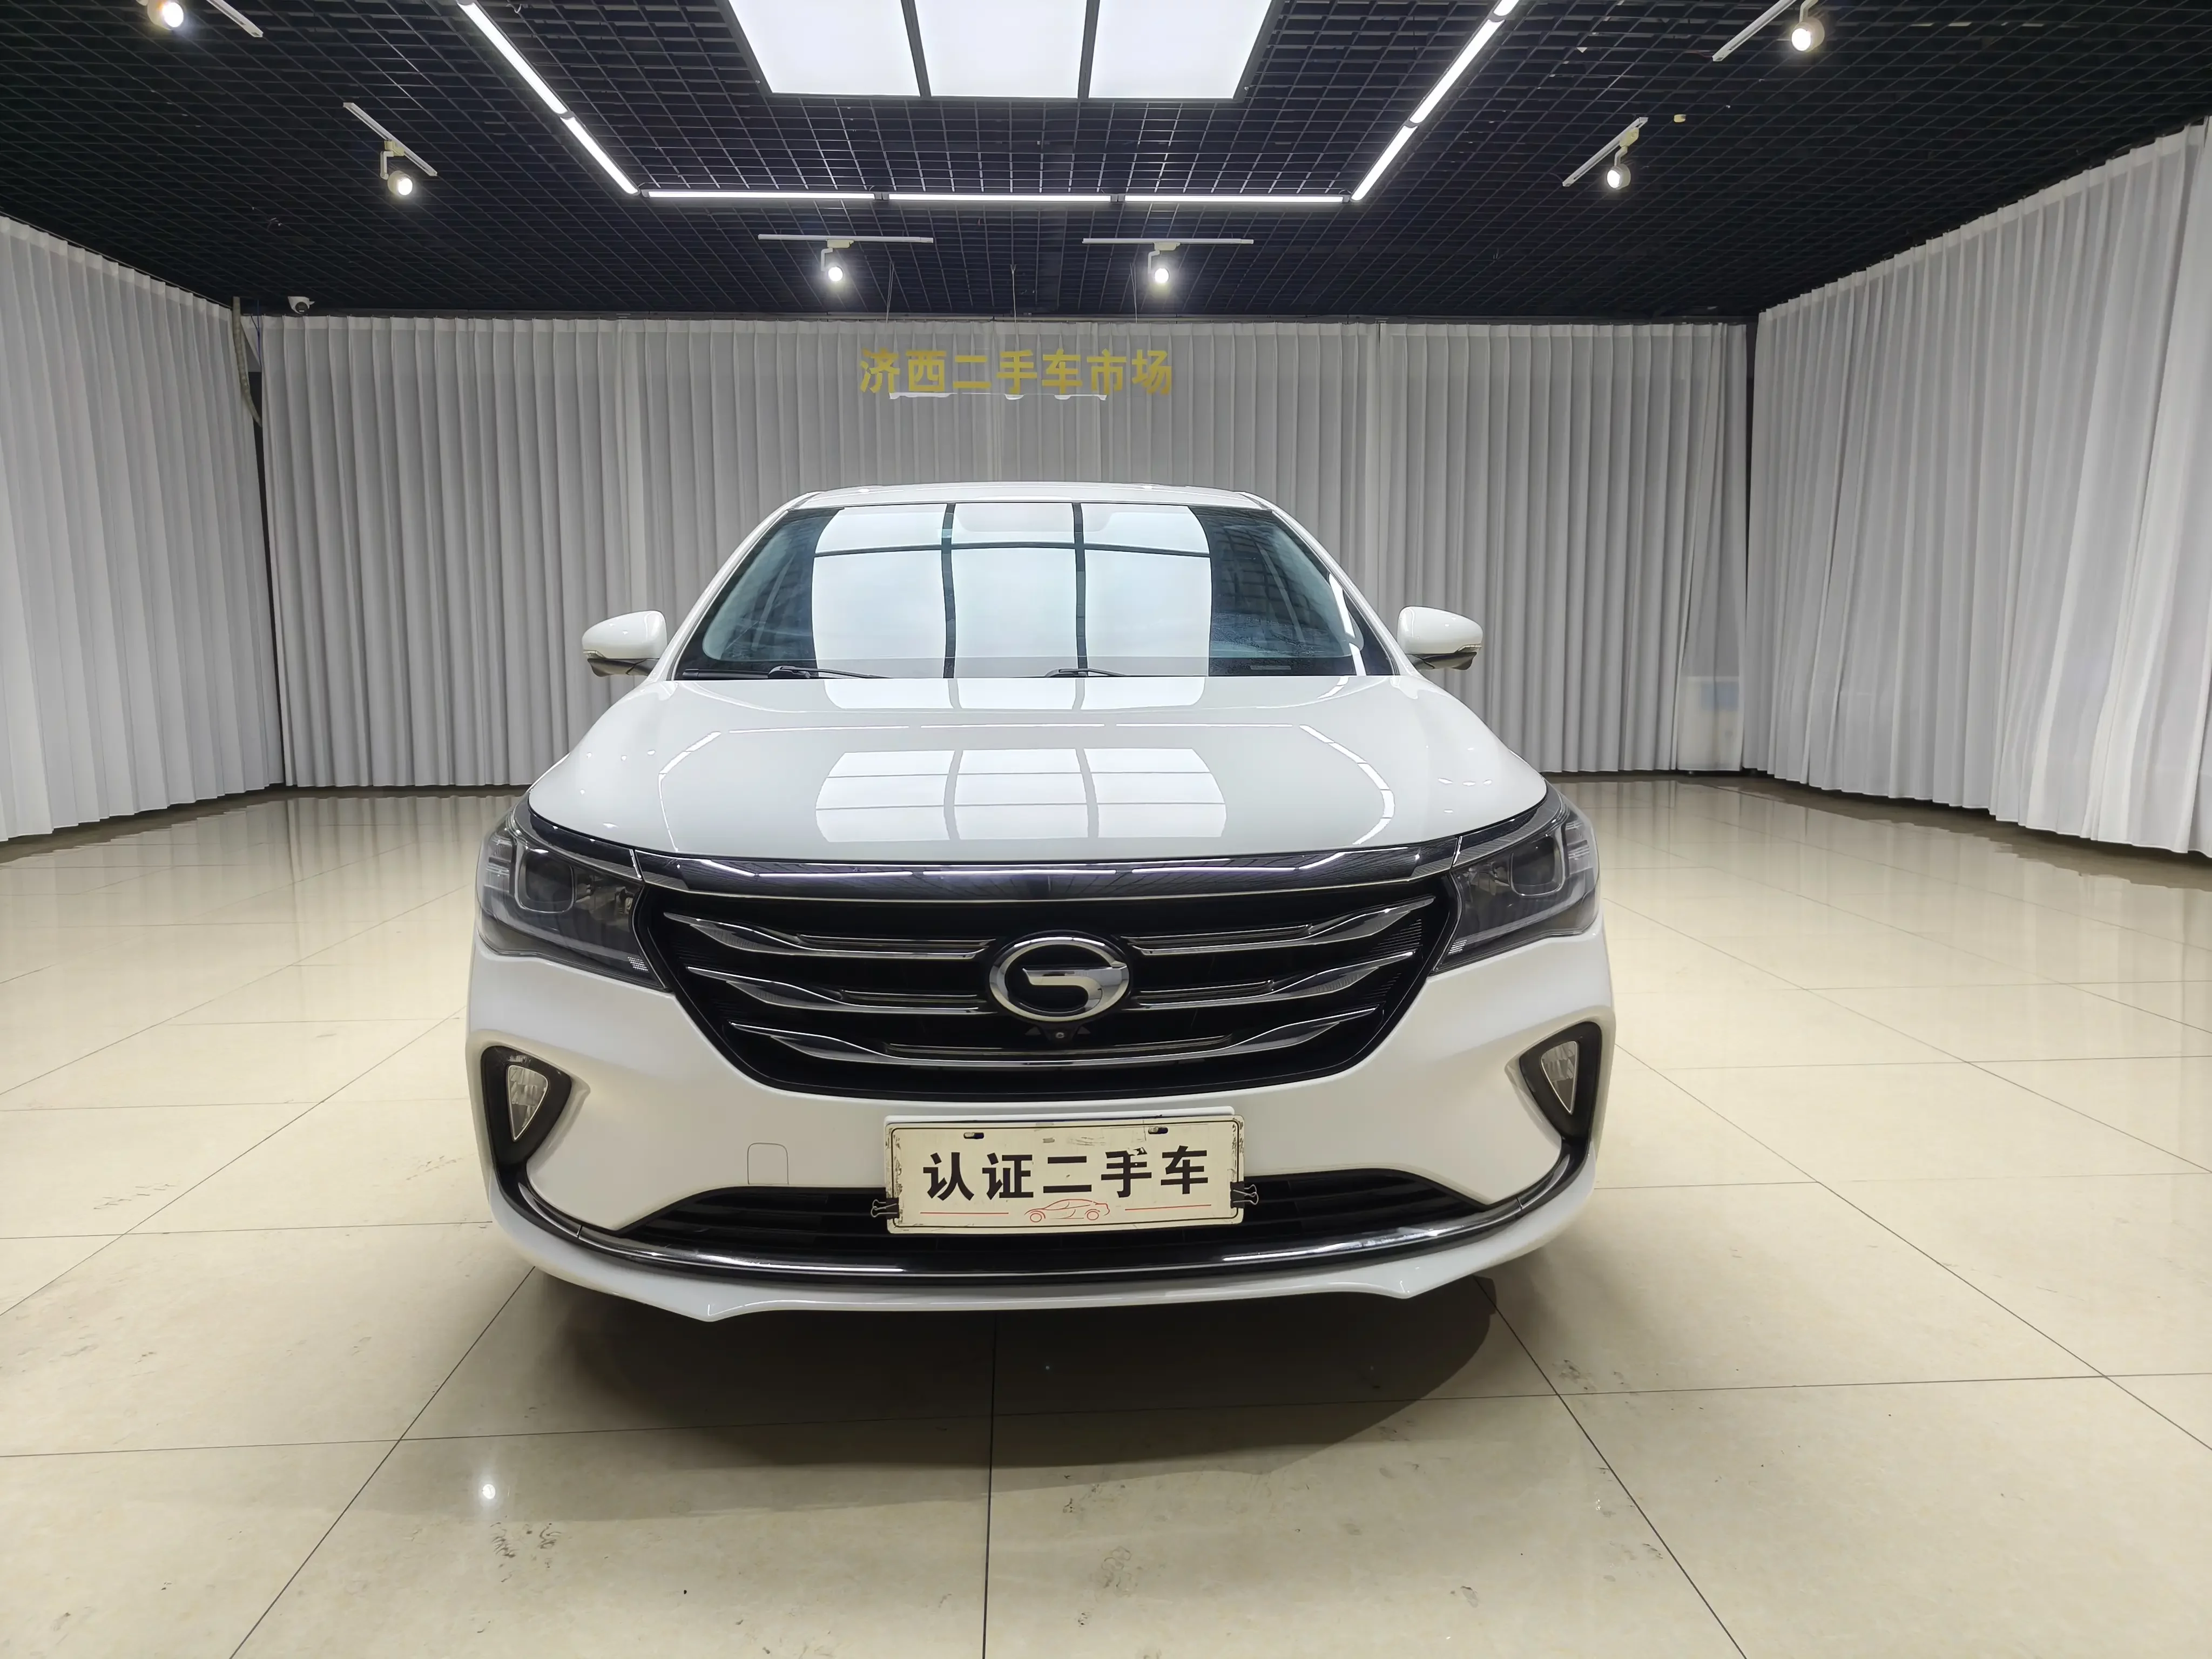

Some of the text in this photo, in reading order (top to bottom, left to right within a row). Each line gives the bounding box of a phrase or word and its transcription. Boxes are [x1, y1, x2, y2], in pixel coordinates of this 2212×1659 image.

[860, 348, 1173, 395] 济西二手车市场
[923, 1145, 1208, 1201] 认证二手车
